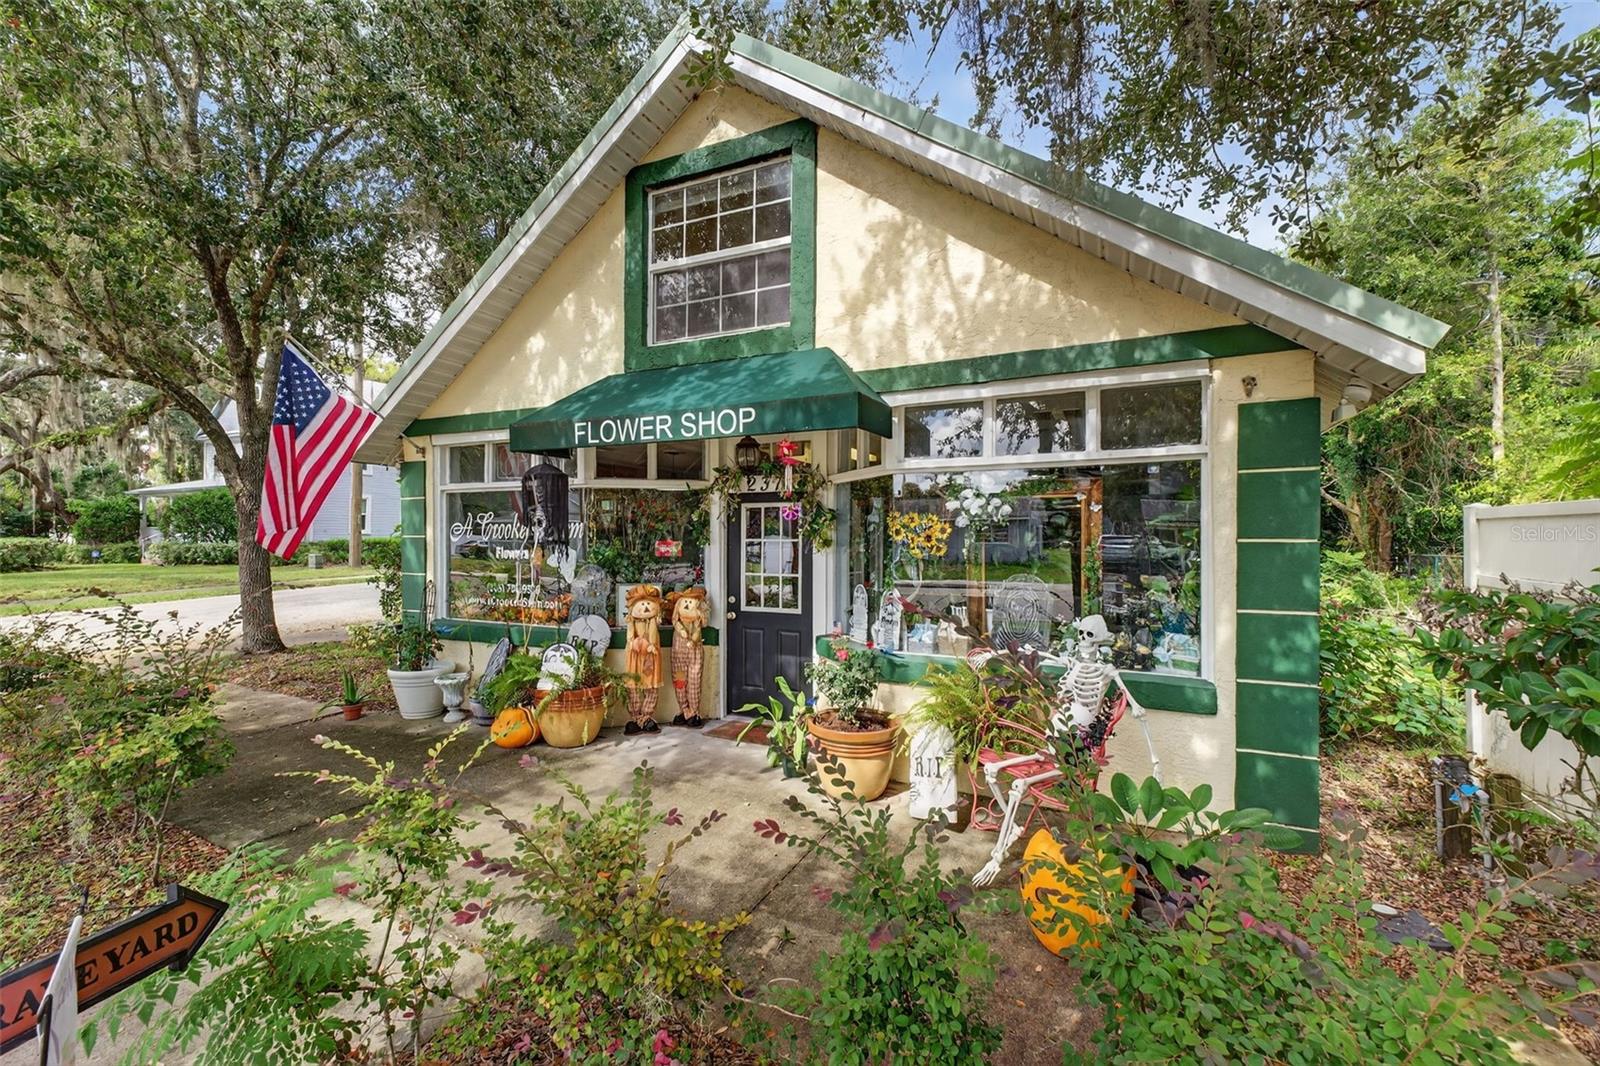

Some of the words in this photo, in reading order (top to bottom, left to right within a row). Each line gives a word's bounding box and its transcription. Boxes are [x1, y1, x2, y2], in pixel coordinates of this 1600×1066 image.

[574, 414, 673, 445] FLOWER
[680, 407, 756, 438] SHOP
[476, 511, 531, 542] Crooke
